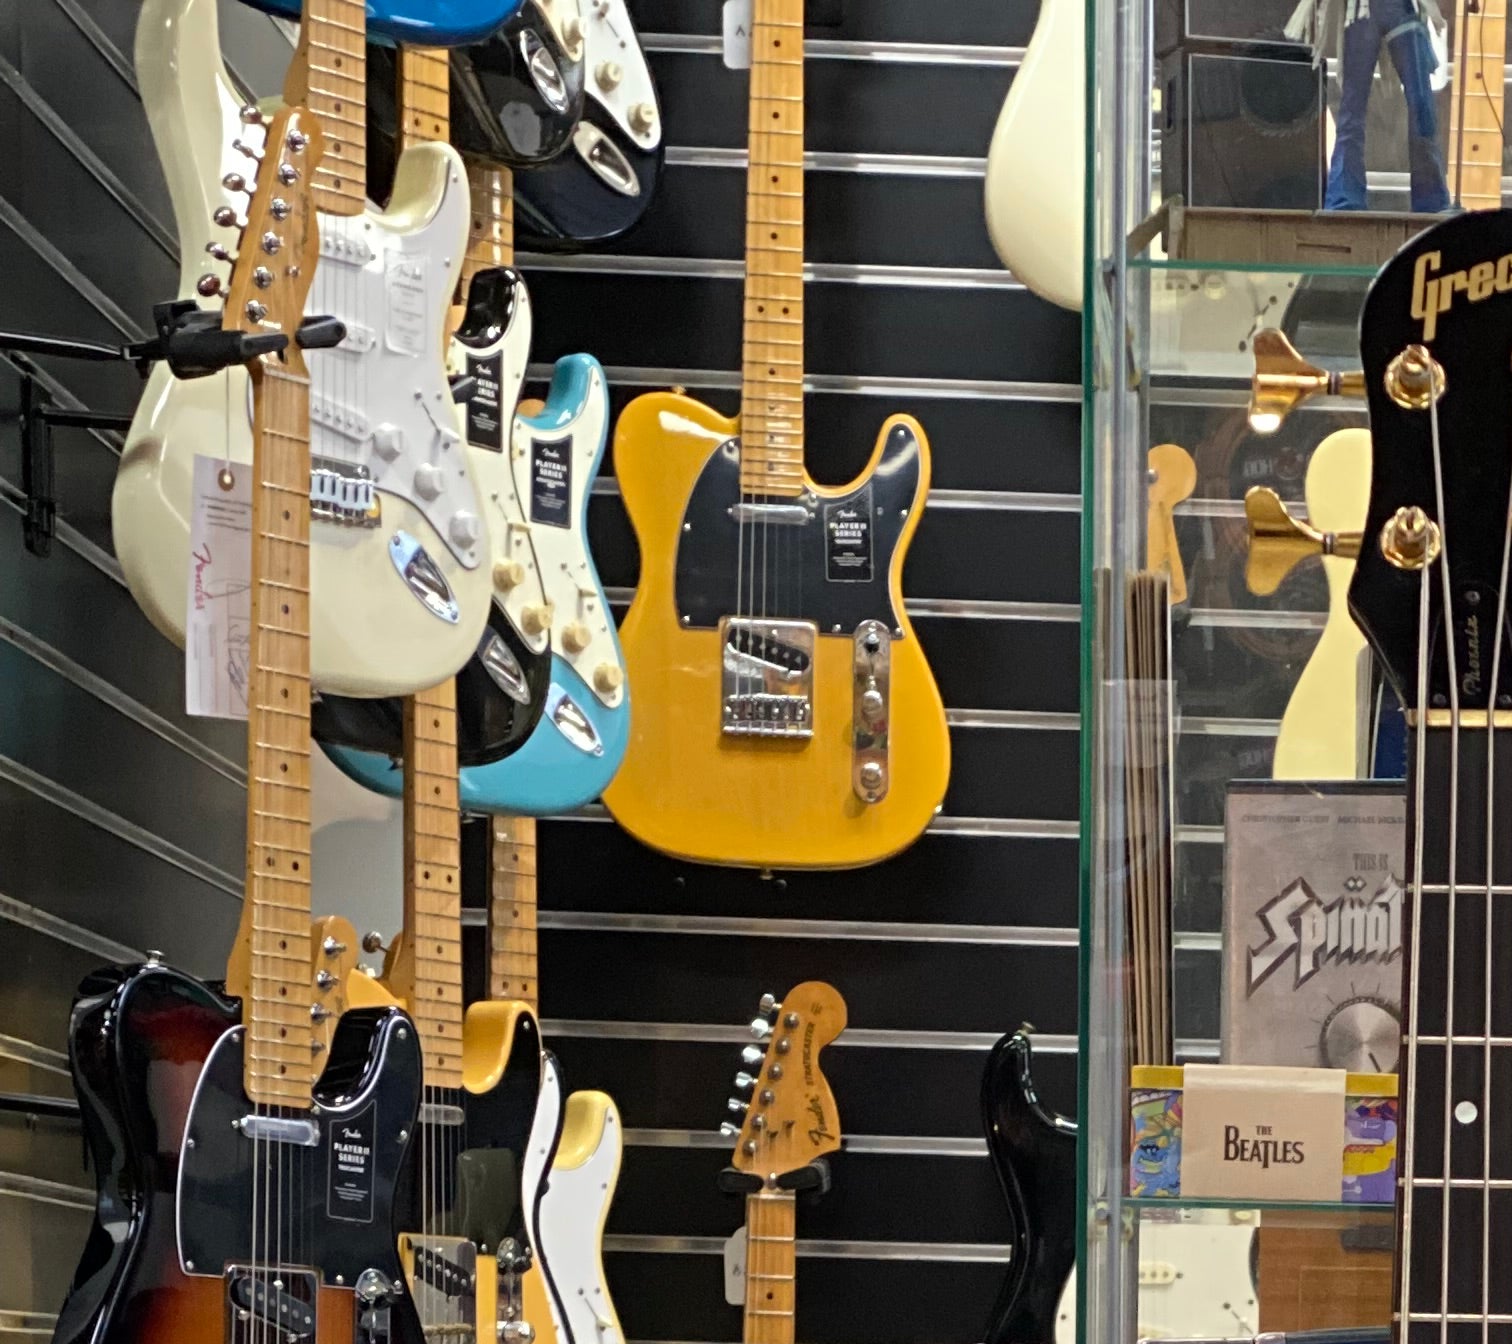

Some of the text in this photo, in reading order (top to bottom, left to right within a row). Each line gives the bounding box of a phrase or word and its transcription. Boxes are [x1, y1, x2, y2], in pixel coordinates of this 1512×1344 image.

[535, 459, 561, 471] PLAYER
[829, 522, 859, 530] PLAYER
[1353, 853, 1389, 871] THIS IS
[1256, 1126, 1272, 1135] THE
[334, 1142, 362, 1154] PLAYER
[1224, 1125, 1305, 1169] BEATLES
[338, 1153, 365, 1165] SERIES
